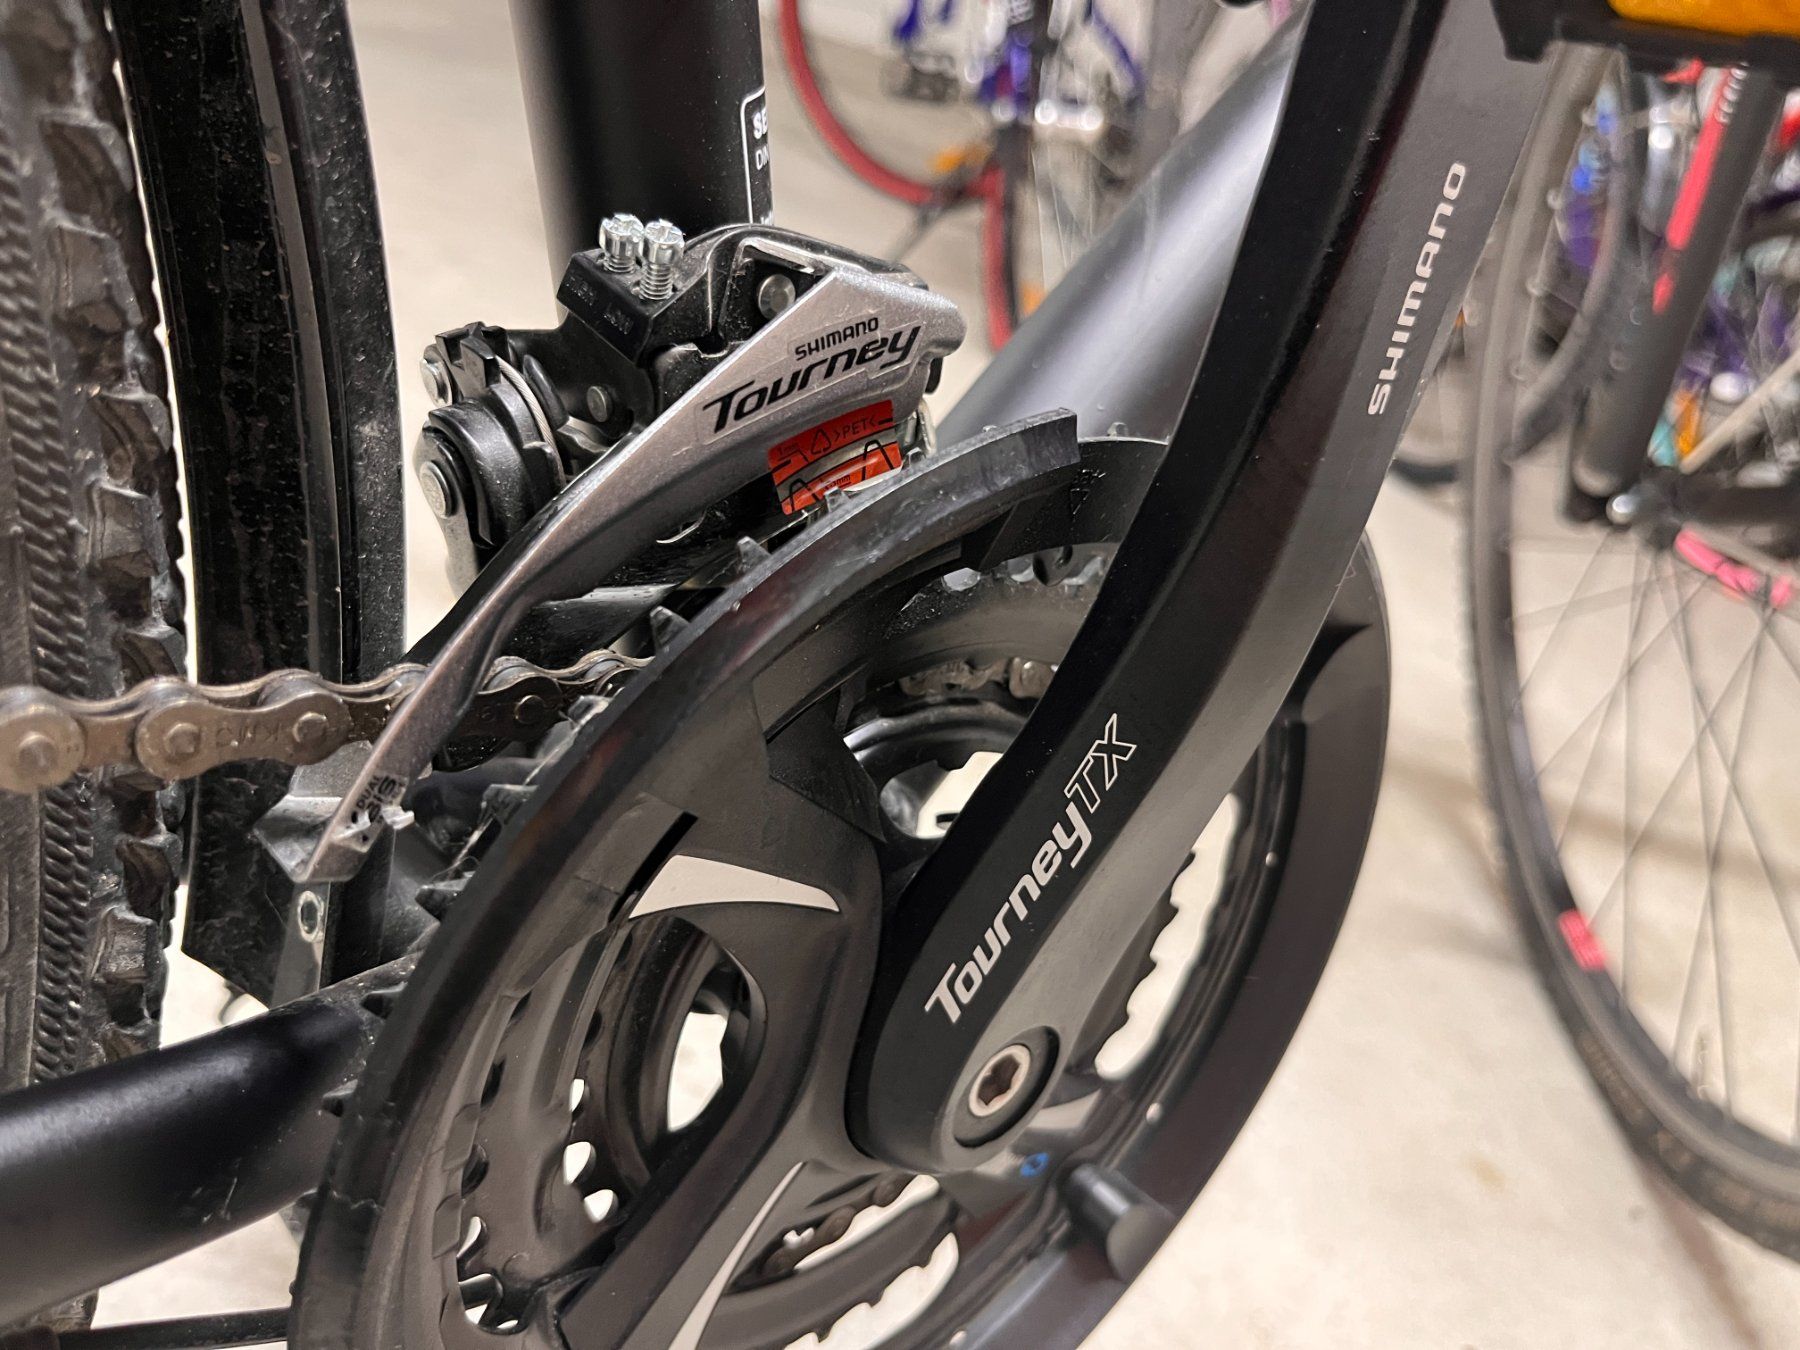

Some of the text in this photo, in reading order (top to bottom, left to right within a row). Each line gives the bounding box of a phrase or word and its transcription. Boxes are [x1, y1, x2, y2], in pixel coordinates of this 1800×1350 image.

[795, 317, 879, 361] SHIMANO
[1367, 162, 1466, 415] SHIMANO
[703, 325, 922, 434] Tourney
